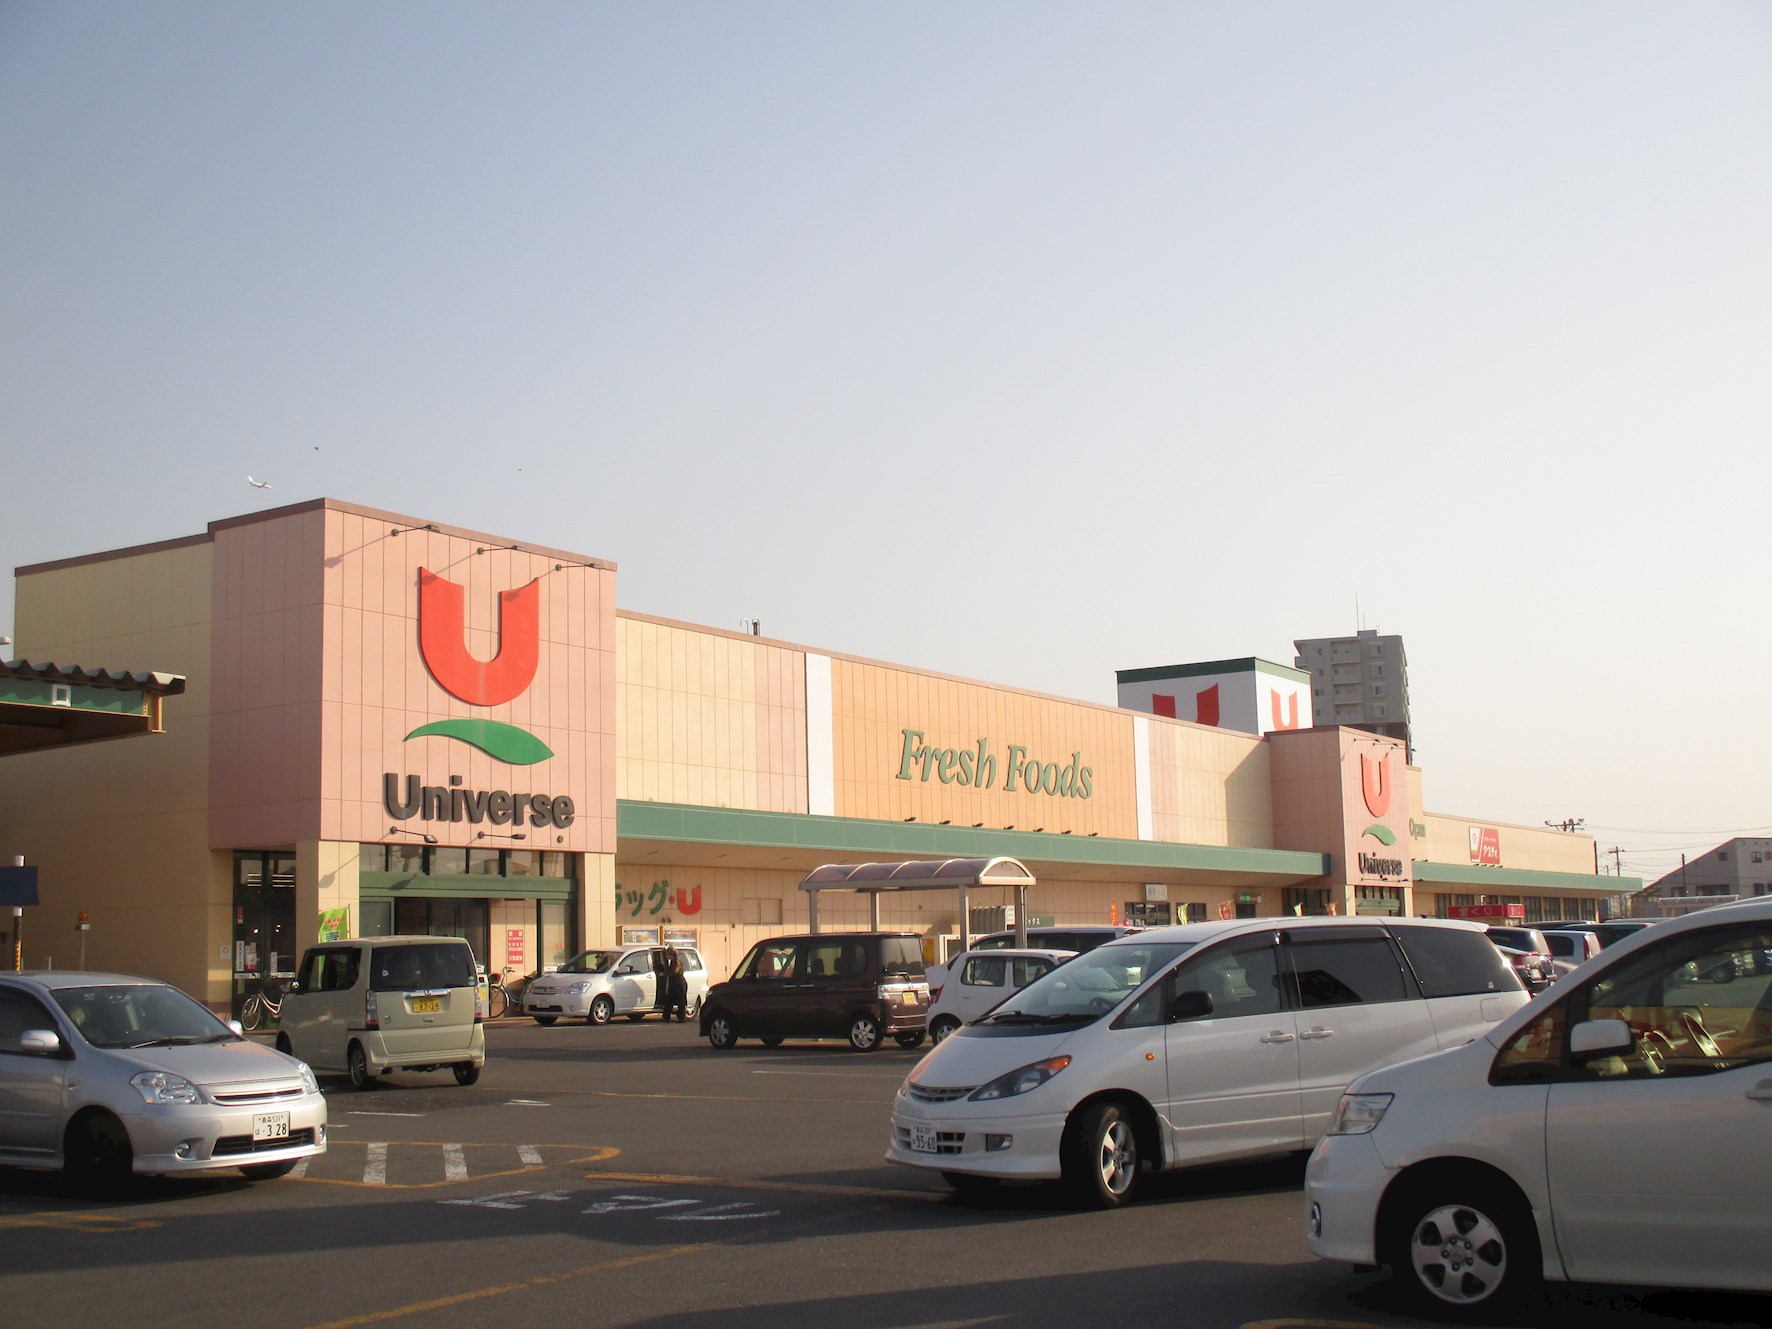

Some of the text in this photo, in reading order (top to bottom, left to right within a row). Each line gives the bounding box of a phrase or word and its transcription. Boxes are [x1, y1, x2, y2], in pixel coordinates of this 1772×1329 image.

[417, 566, 540, 707] U
[896, 729, 1094, 799] Fresh Foods
[1360, 752, 1391, 818] U
[384, 773, 575, 829] Universe
[1358, 852, 1403, 876] Universe
